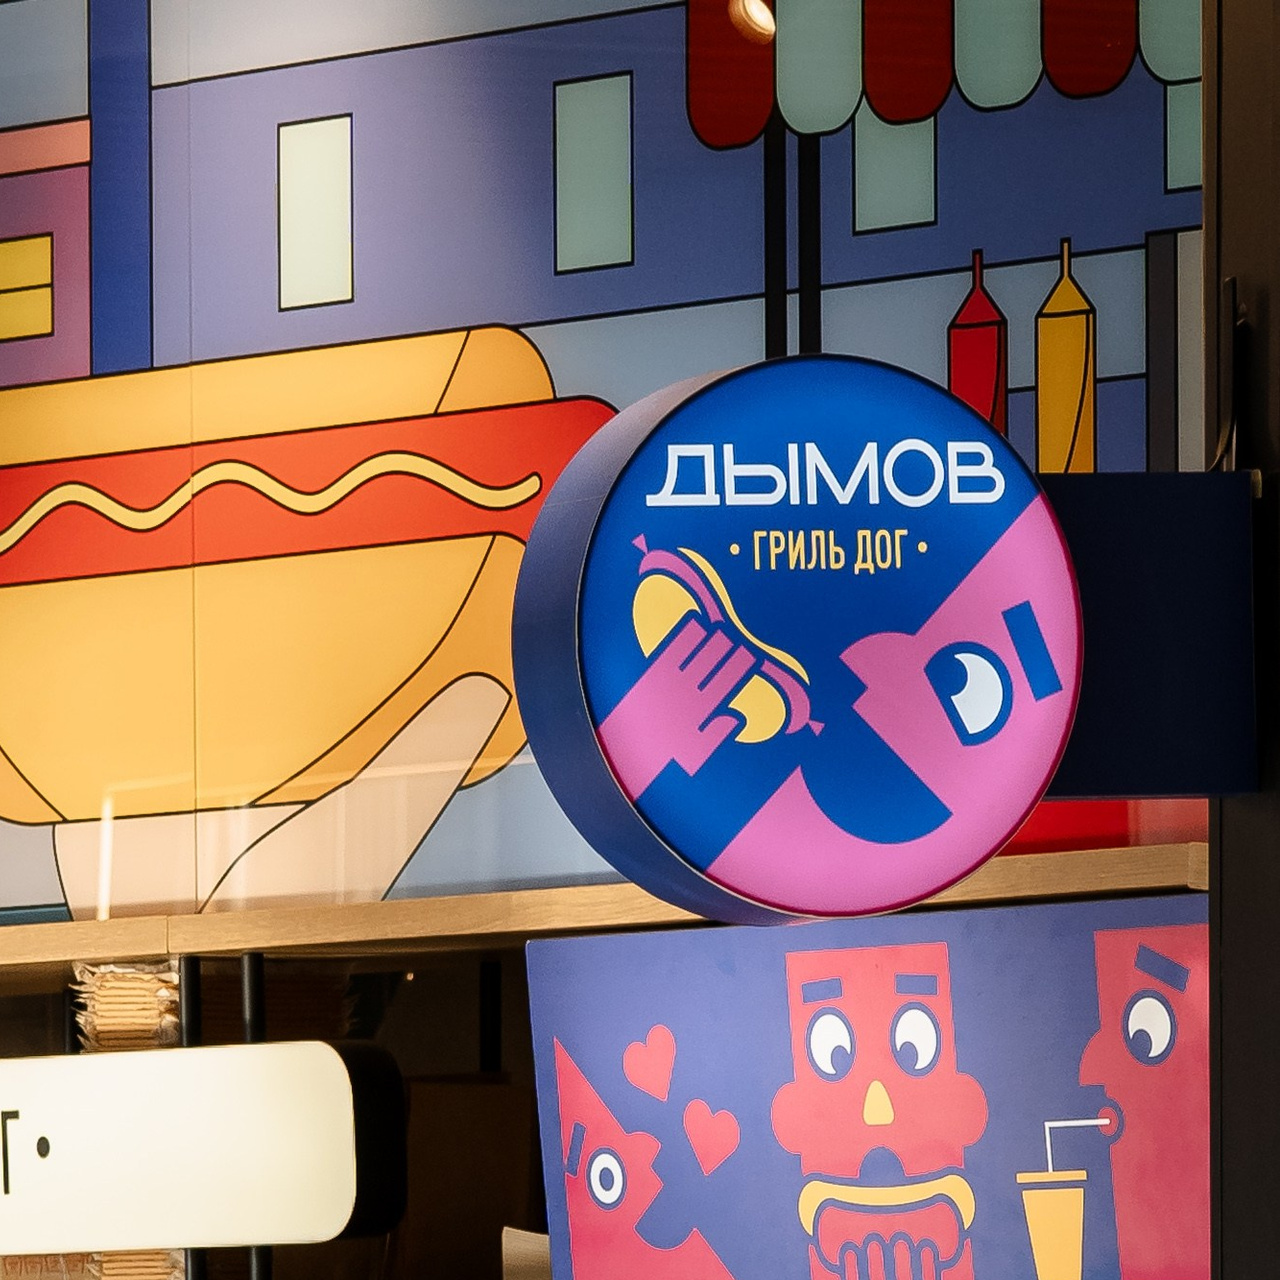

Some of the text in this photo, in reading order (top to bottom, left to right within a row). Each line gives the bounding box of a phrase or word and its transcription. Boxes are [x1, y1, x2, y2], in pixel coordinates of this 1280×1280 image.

[646, 438, 1006, 507] ДЫМОВ
[753, 529, 909, 574] ГРИЛЬ ДОГ
